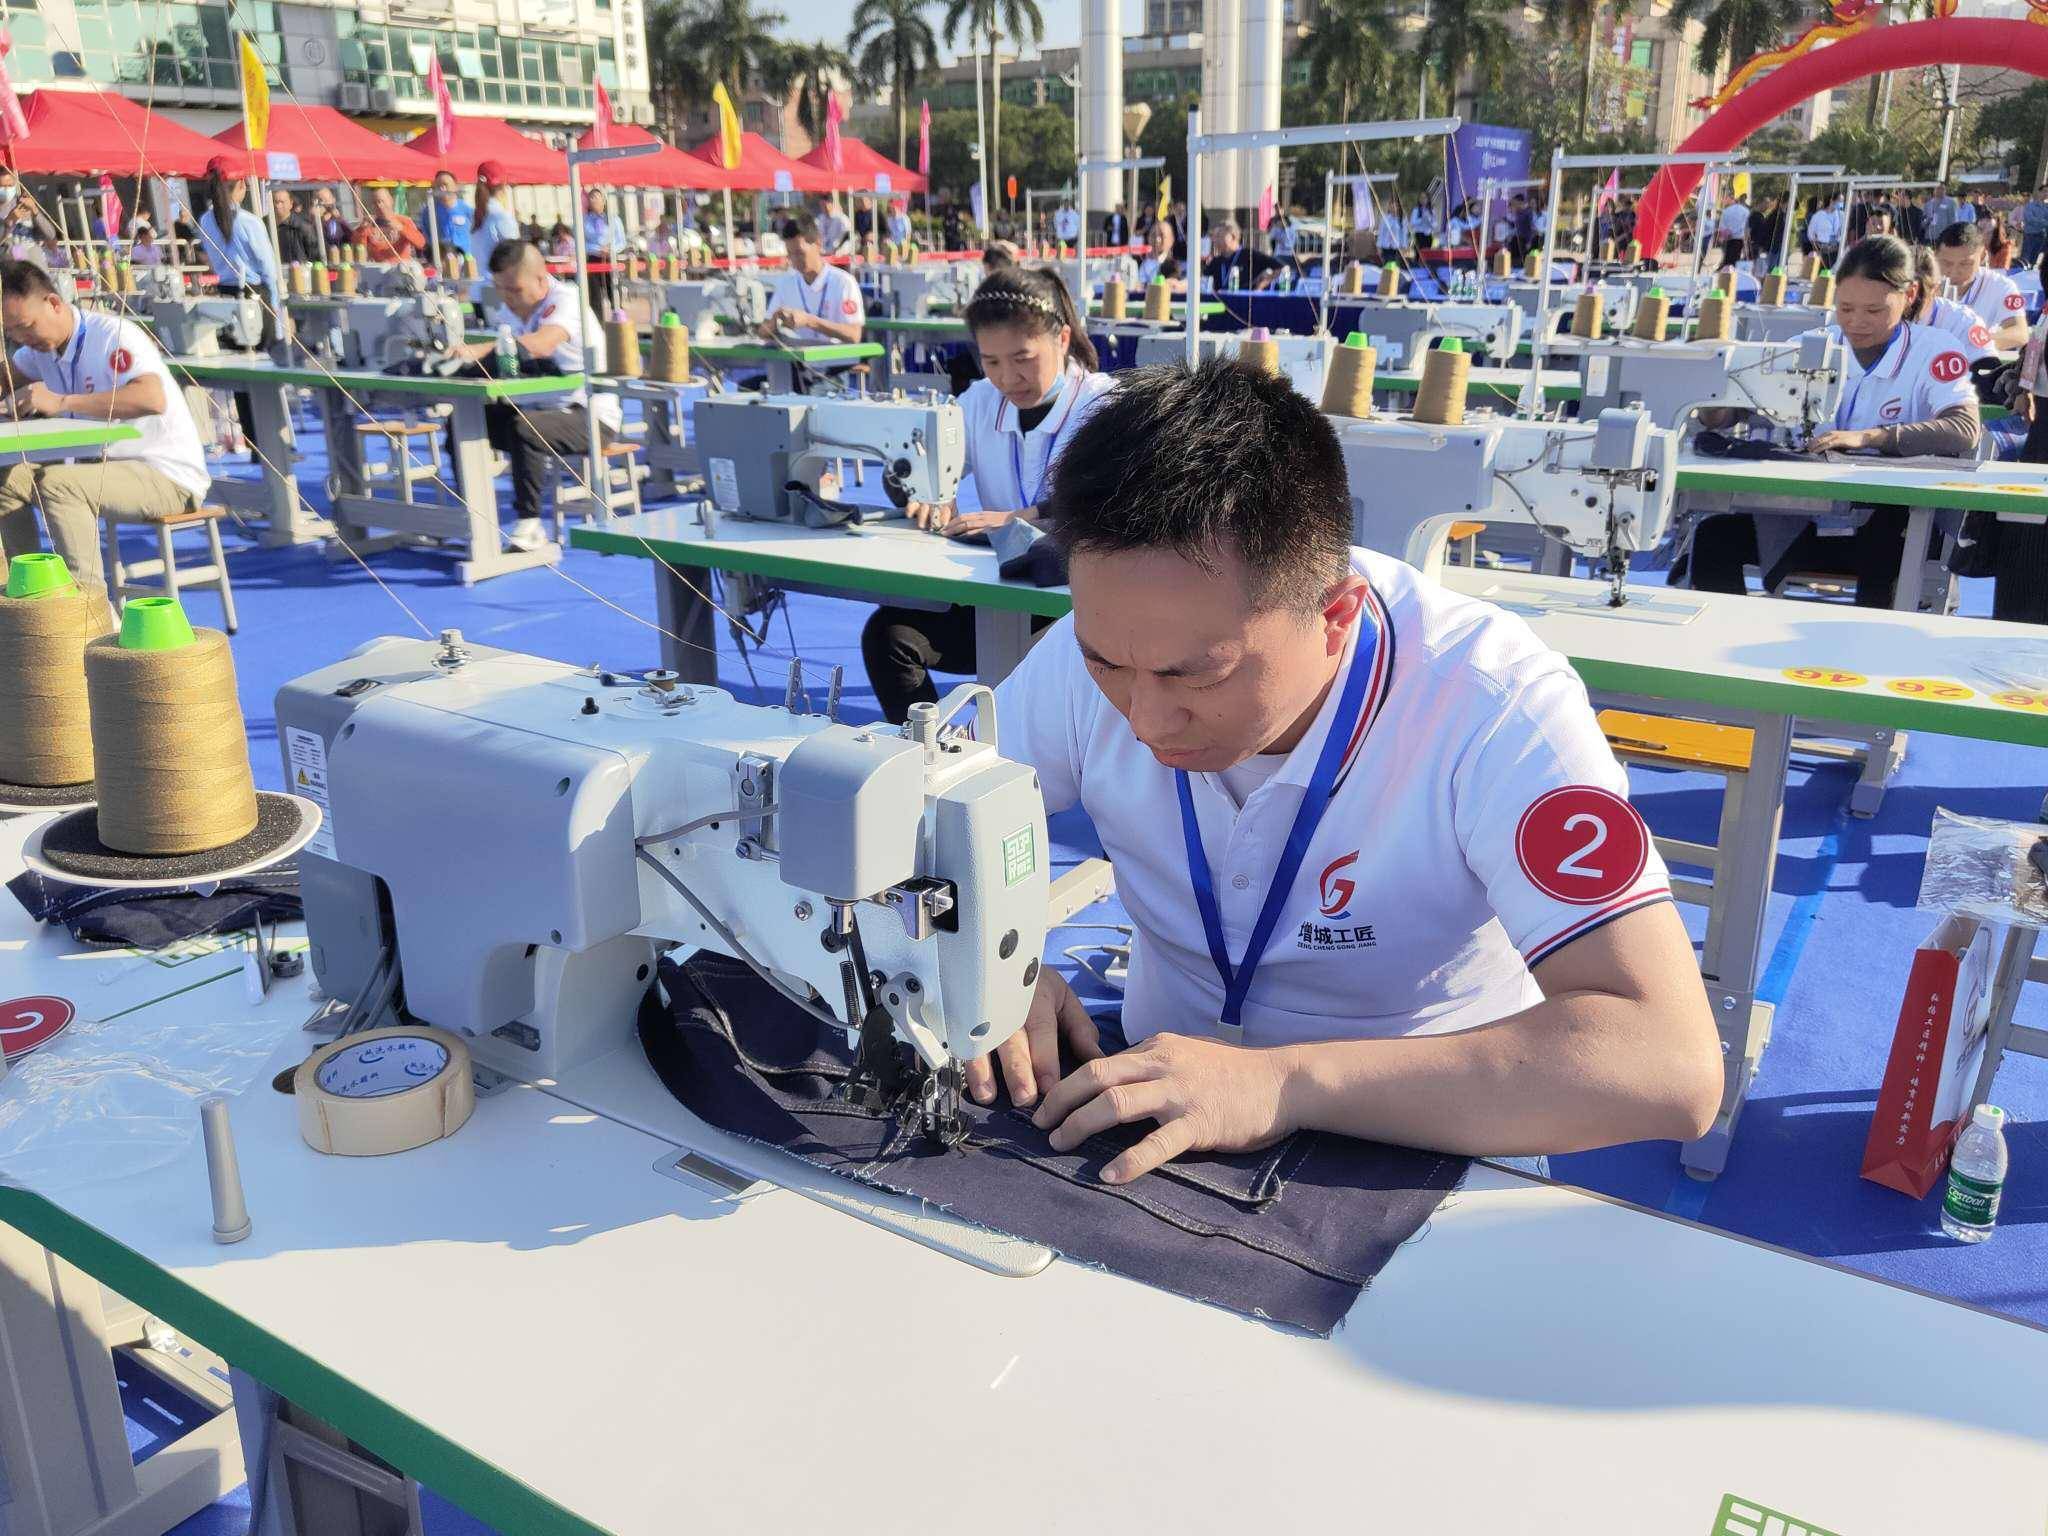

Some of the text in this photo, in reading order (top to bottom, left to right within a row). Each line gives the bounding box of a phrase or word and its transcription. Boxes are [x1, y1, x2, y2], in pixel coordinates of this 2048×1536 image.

[1935, 356, 1963, 377] 10
[1556, 813, 1608, 879] 2
[1297, 920, 1376, 945] 增城工匠
